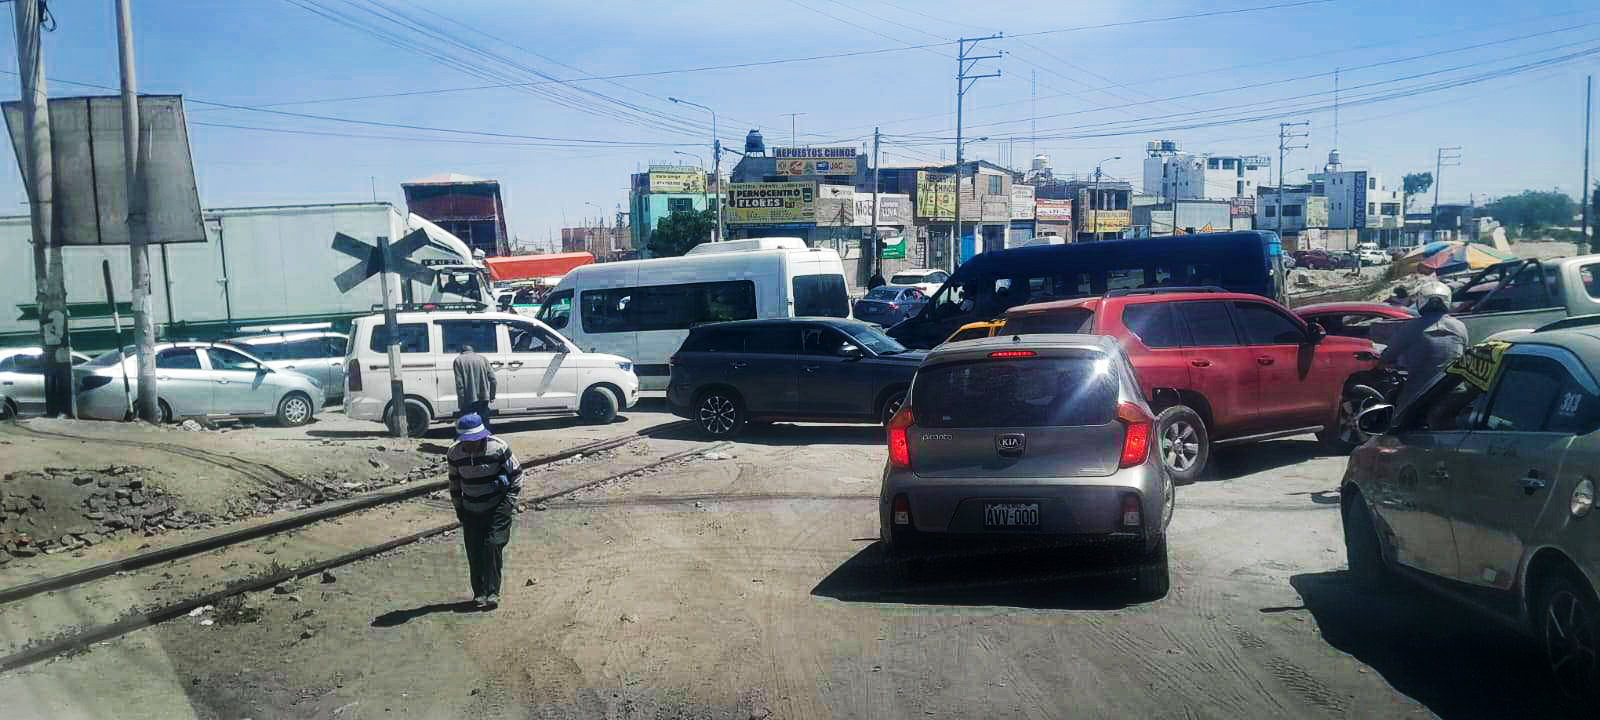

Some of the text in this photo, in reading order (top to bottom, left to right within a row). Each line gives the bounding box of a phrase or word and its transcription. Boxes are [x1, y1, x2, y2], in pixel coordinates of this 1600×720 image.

[776, 147, 856, 158] REPUESTOS CHINOS
[738, 198, 781, 208] FLORES
[1002, 438, 1019, 446] KIA
[987, 509, 1037, 525] AVV-000
